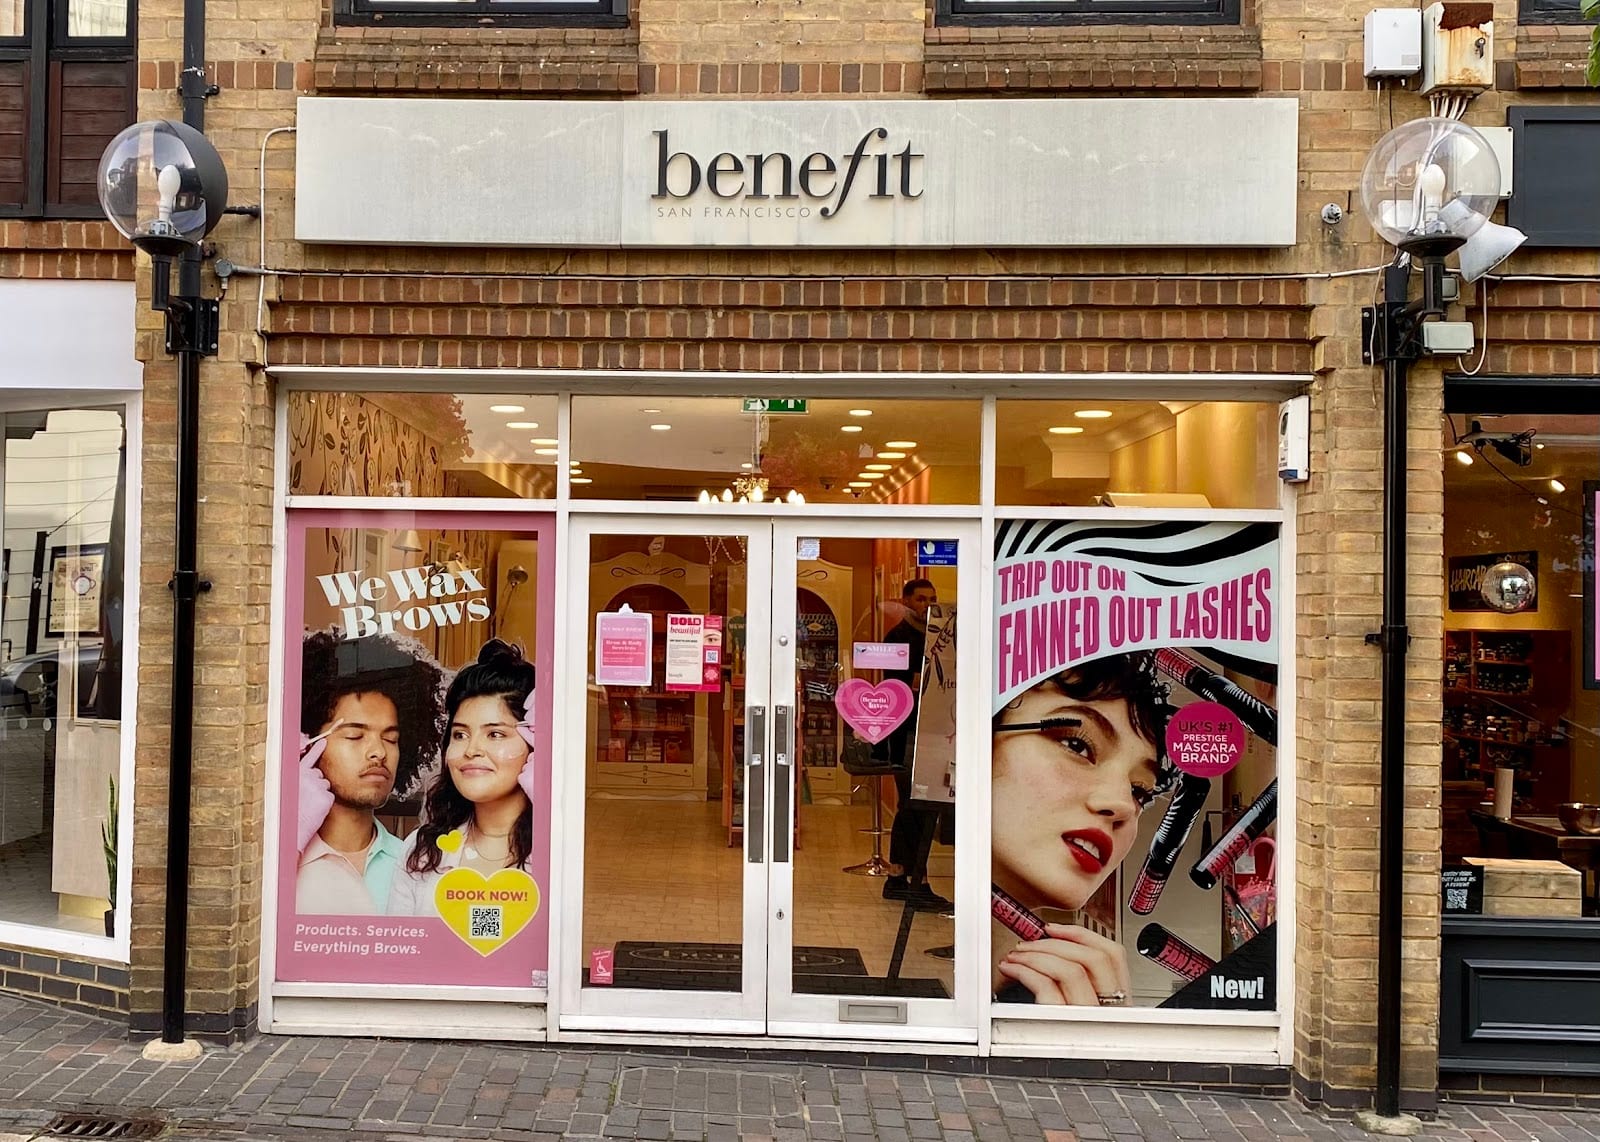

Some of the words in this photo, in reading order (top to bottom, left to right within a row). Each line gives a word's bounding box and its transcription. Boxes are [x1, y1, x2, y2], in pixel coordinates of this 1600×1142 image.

[651, 127, 925, 218] benefit
[657, 207, 692, 218] SAN
[703, 207, 811, 218] FRANCISCO
[315, 570, 388, 607] We
[386, 564, 488, 602] Wax
[998, 561, 1047, 606] TRIP
[1051, 560, 1092, 594] OUT
[1097, 565, 1126, 592] ON
[340, 597, 491, 641] Brows
[670, 617, 702, 626] BOLD
[669, 627, 701, 636] beautiful
[998, 596, 1100, 695] FANNED
[1108, 596, 1162, 648] OUT
[1169, 568, 1272, 643] LASHES
[1178, 721, 1213, 733] UK'S
[1217, 722, 1233, 733] #1
[1183, 734, 1228, 742] PRESTIGE
[1173, 742, 1238, 753] MASCARA
[446, 890, 486, 901] BOOK
[489, 890, 529, 902] NOW!
[295, 924, 362, 937] Products.
[366, 925, 430, 938] Services.
[293, 941, 370, 955] Everything
[374, 942, 421, 955] Brows.
[1210, 975, 1265, 1000] New!
